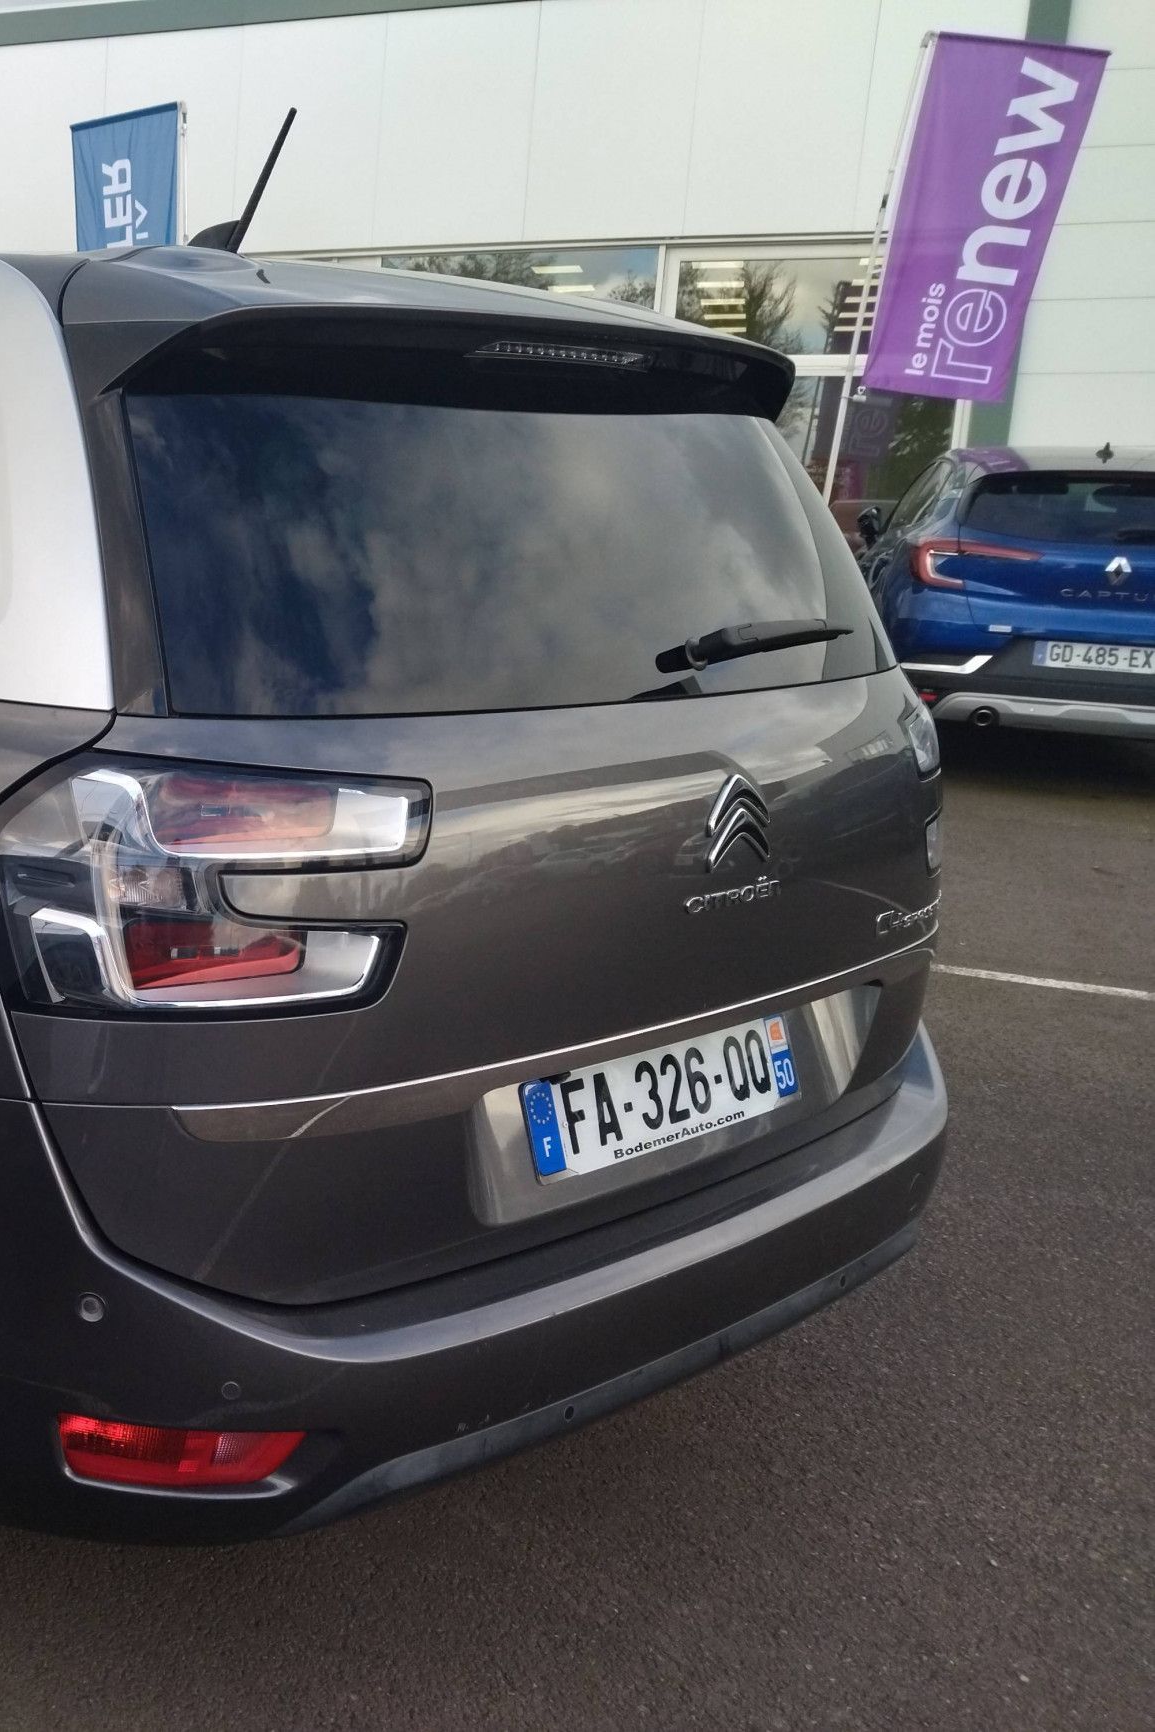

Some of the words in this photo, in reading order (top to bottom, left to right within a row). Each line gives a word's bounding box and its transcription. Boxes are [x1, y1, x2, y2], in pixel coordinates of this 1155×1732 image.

[930, 56, 1080, 384] renew
[915, 282, 946, 348] mois
[904, 352, 928, 376] le
[1060, 588, 1155, 602] CAPTU
[1049, 643, 1155, 669] GD-485-EX
[684, 875, 781, 914] CITROËN
[774, 1058, 795, 1089] 50
[560, 1029, 772, 1155] FA-326-QQ
[543, 1137, 551, 1158] F
[613, 1109, 745, 1160] BodemerAuto.com
